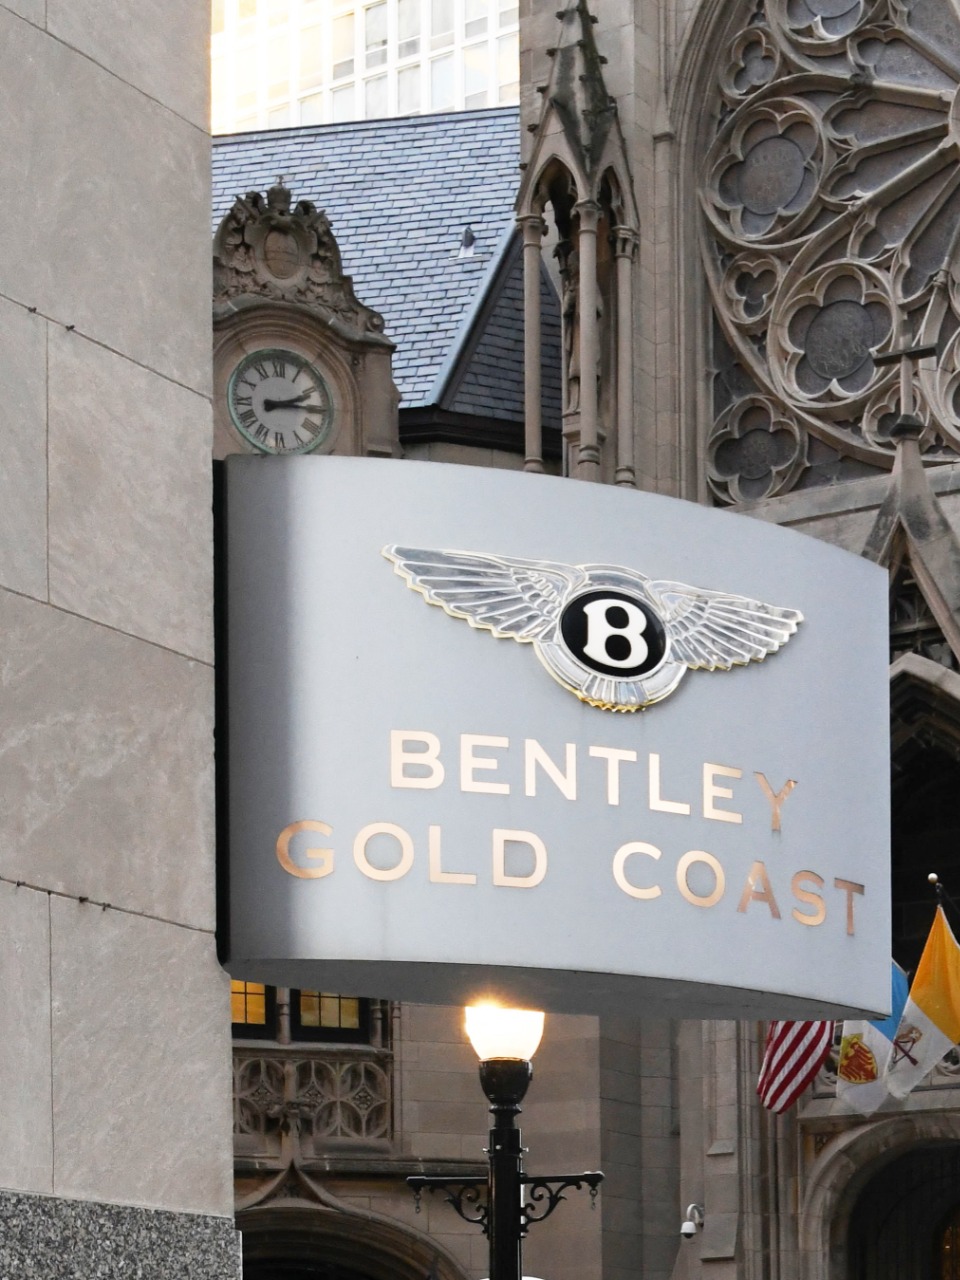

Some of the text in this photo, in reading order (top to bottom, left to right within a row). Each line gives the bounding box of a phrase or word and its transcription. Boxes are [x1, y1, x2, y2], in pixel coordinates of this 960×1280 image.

[583, 598, 649, 669] B
[390, 729, 798, 832] BENTLEY
[275, 820, 866, 937] GOLD COAST
